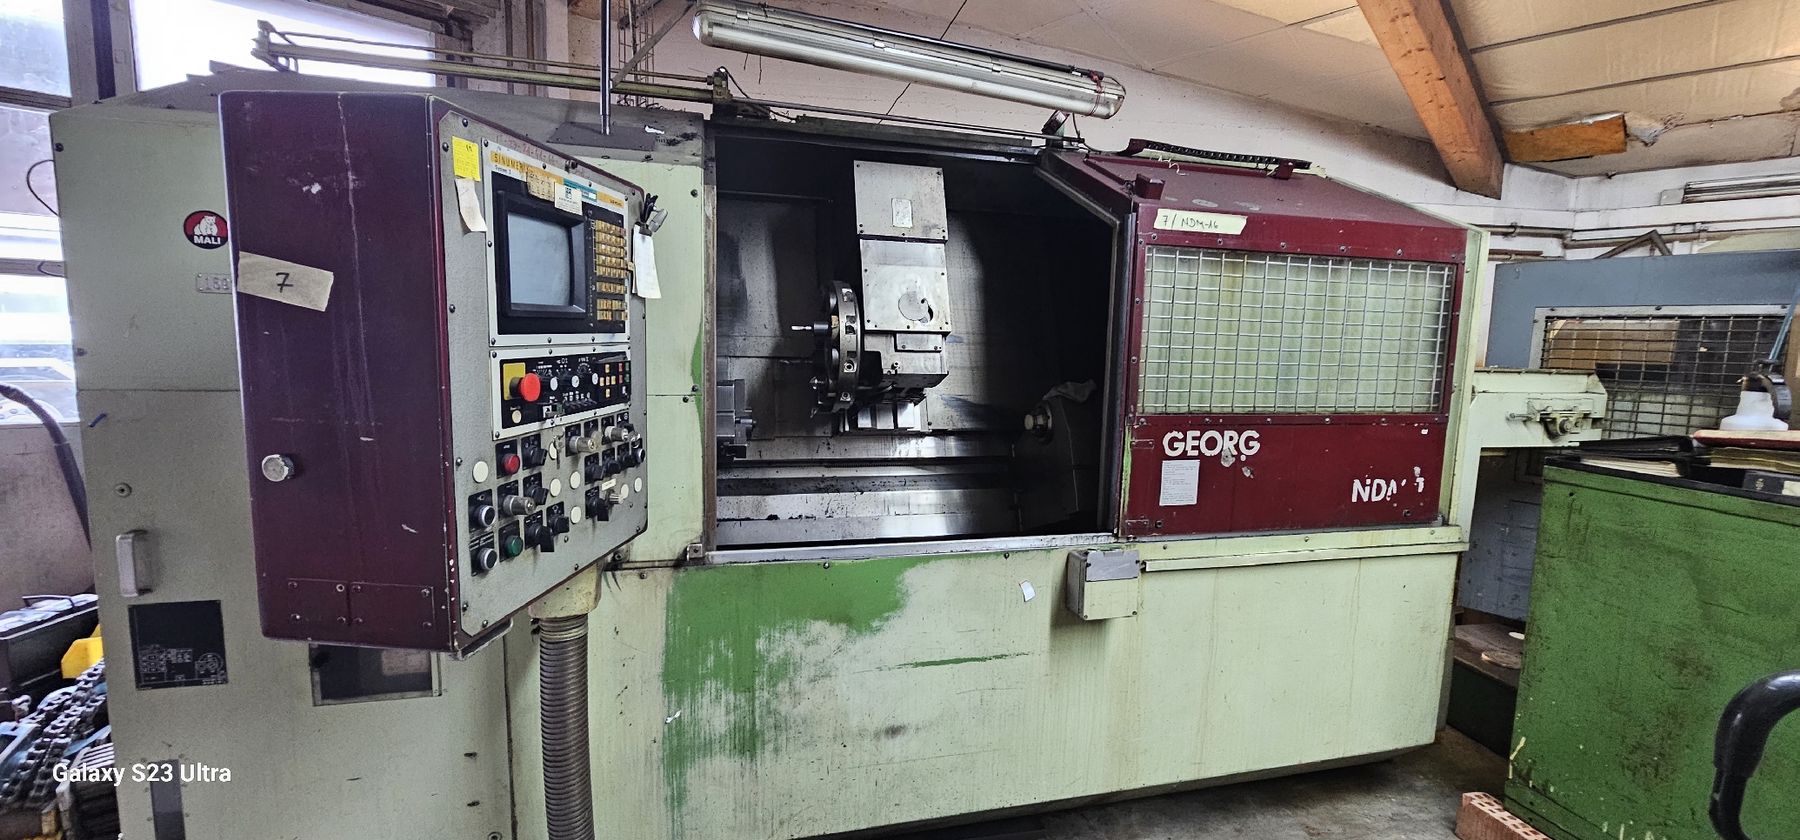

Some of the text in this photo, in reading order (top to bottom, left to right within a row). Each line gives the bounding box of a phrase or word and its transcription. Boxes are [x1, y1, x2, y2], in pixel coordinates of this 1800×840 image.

[193, 235, 221, 245] MALI
[275, 272, 294, 293] 7
[1162, 430, 1260, 457] GEORG
